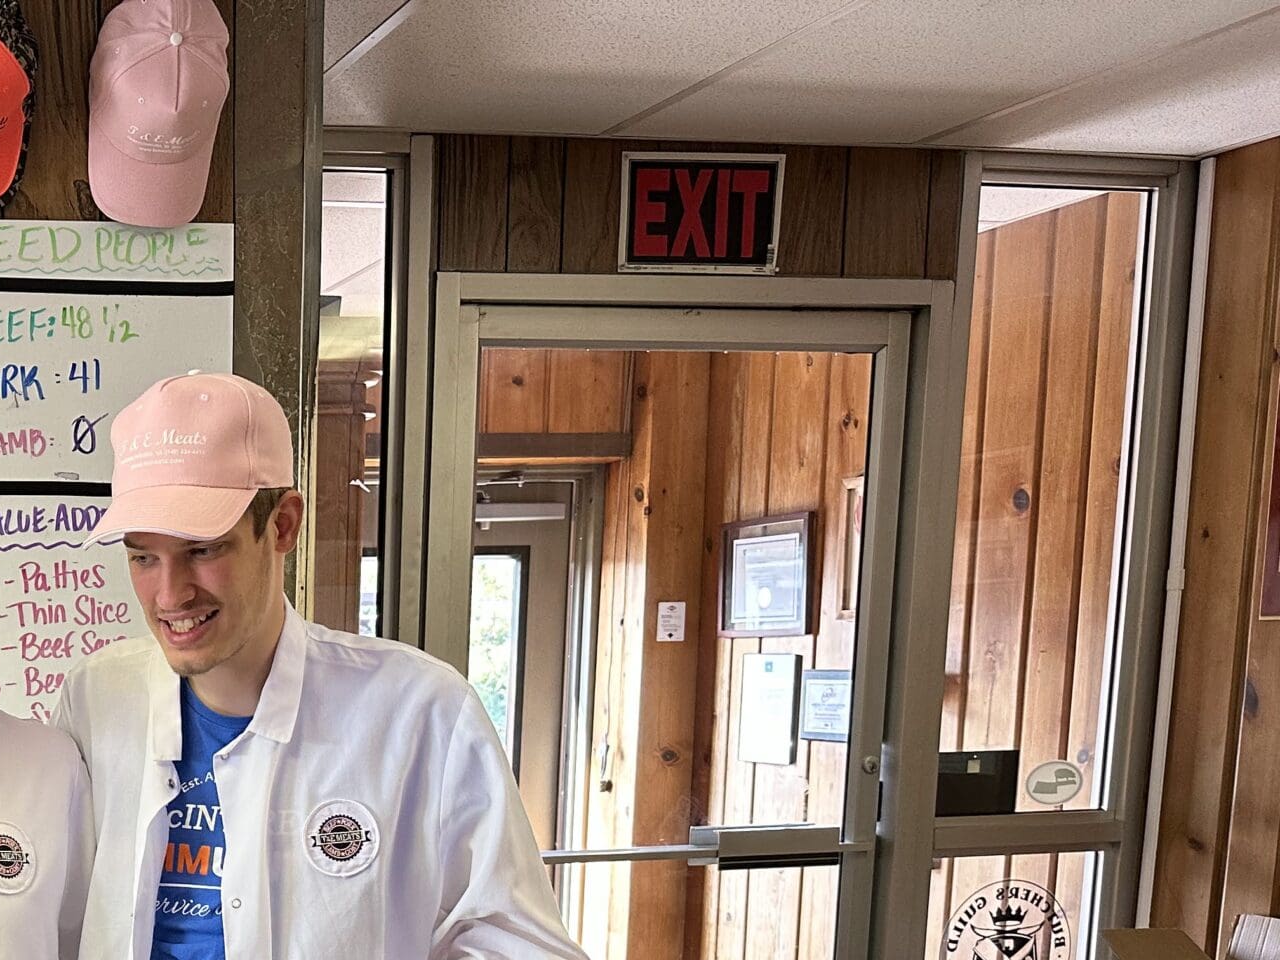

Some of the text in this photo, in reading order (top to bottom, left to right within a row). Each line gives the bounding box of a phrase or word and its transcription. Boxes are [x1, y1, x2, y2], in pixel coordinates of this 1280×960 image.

[633, 167, 770, 258] EXIT
[60, 305, 94, 340] 48
[68, 358, 102, 394] 41
[157, 428, 207, 446] Meats
[18, 559, 107, 596] Patties
[5, 598, 67, 628] Thin
[72, 594, 132, 627] Slice
[18, 630, 76, 662] Beef
[181, 775, 203, 794] Est.
[154, 894, 212, 919] ervice
